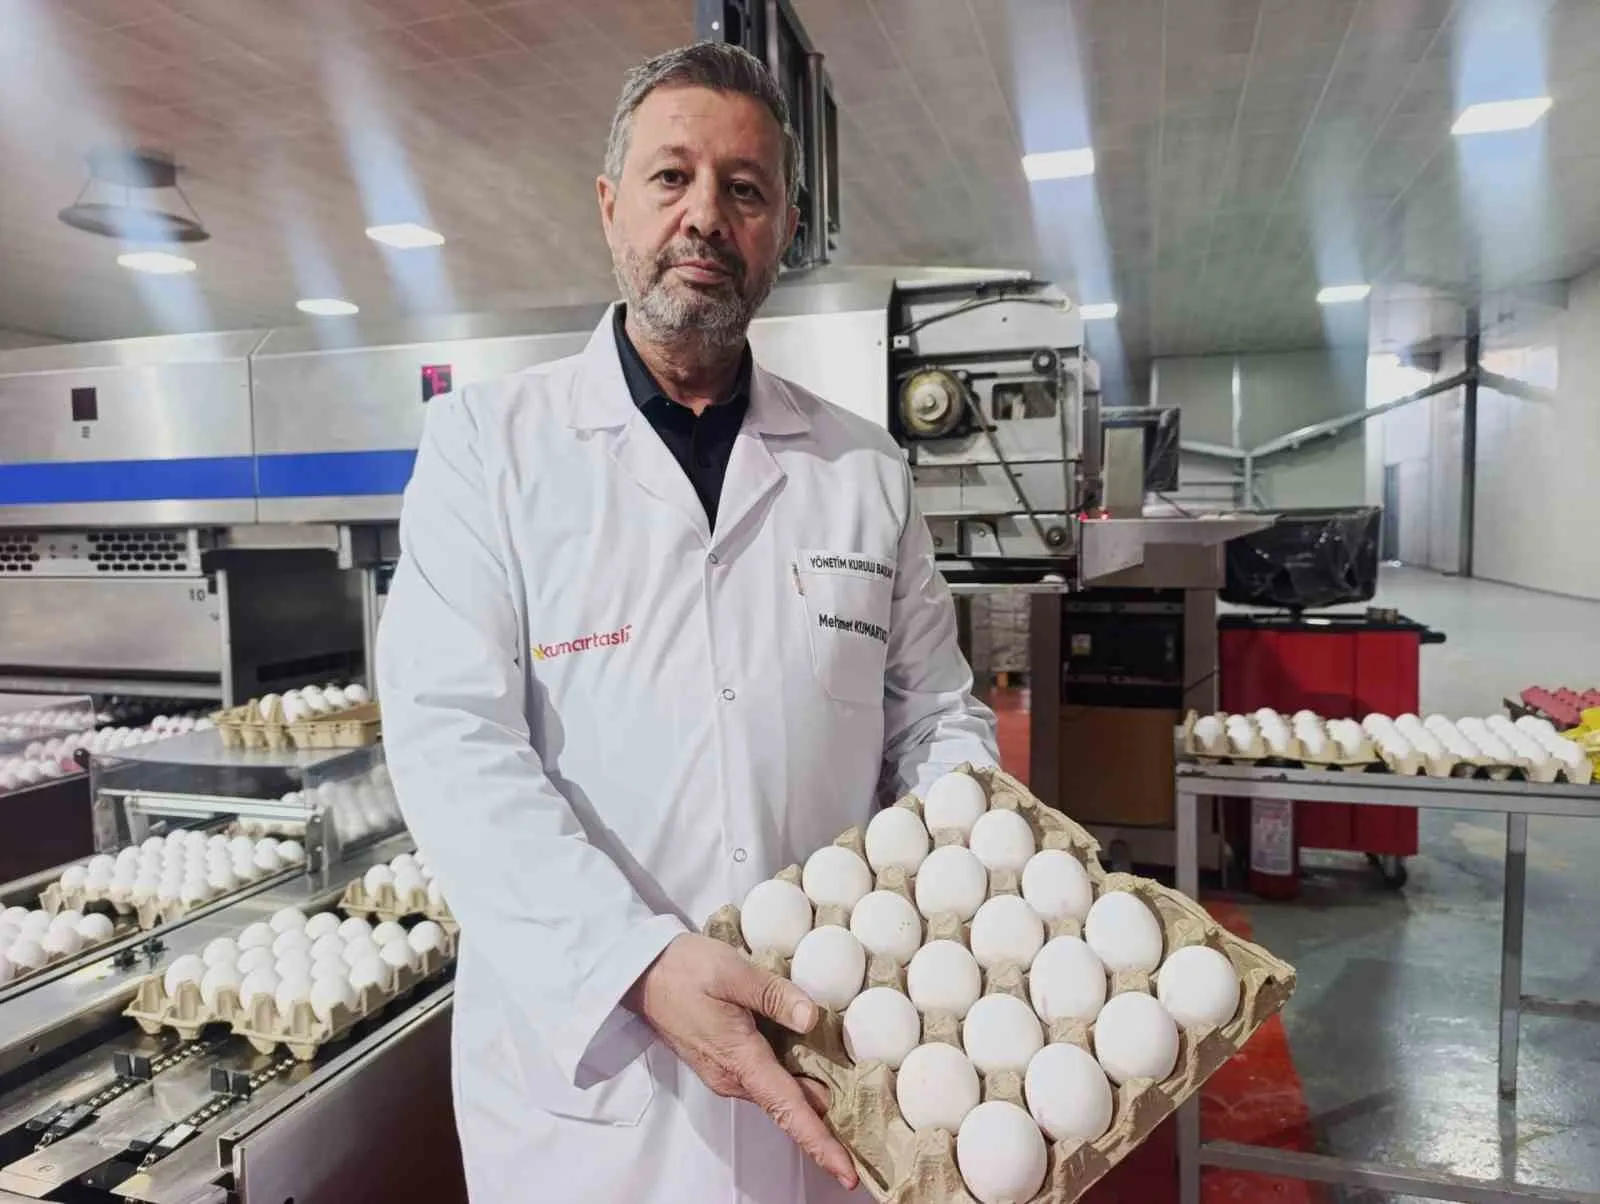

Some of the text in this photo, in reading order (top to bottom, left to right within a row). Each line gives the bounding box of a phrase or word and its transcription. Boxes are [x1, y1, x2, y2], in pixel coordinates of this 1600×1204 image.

[810, 555, 847, 569] YÖNETİM
[849, 559, 875, 573] KURULU
[189, 588, 206, 601] 10
[819, 614, 853, 632] Mehmet
